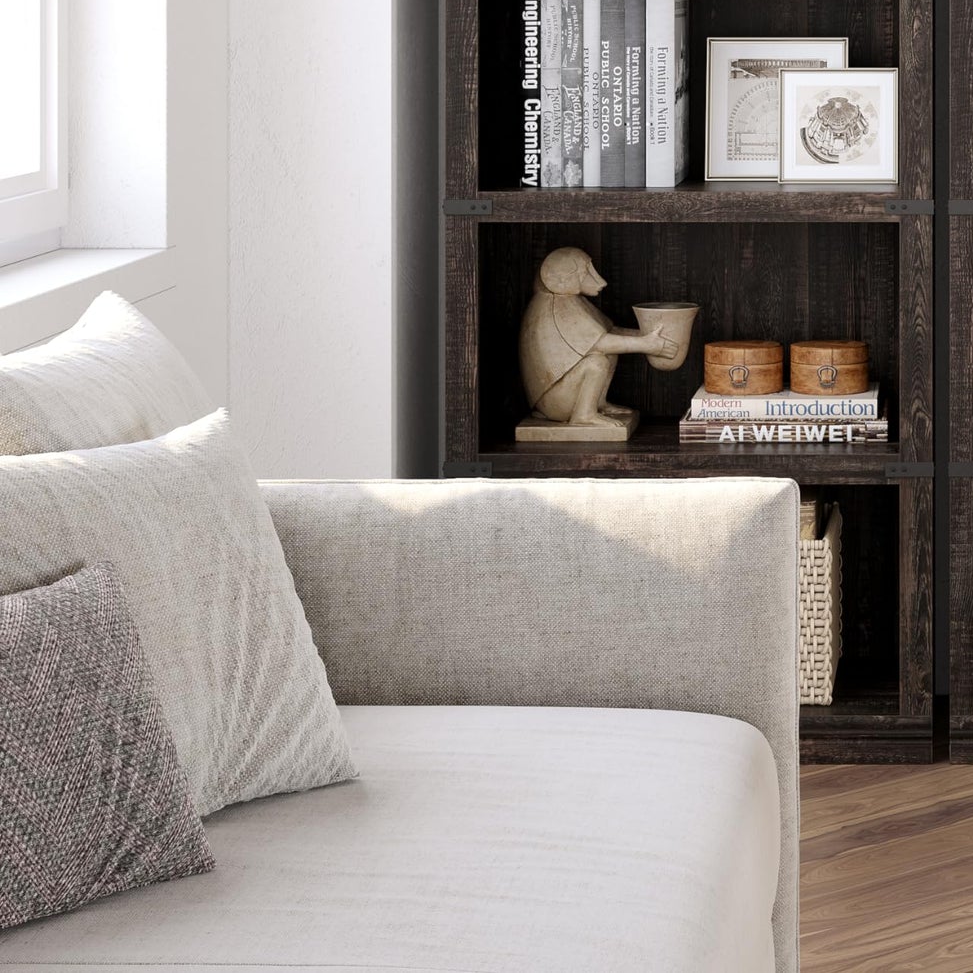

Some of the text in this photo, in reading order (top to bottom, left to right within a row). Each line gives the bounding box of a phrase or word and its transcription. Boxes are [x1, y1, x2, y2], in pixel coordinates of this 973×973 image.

[562, 84, 582, 136] ENGLAND
[592, 72, 600, 129] ONTARIO
[601, 40, 610, 150] PUBLIC SCHOOL
[613, 66, 623, 127] ONTARIO
[630, 46, 641, 145] Forming a Nation
[656, 46, 669, 145] Forming a Nation
[522, 99, 541, 187] Chemistry
[698, 408, 750, 418] American
[701, 398, 742, 408] Modern
[765, 400, 875, 416] Introduction
[719, 425, 853, 442] AI WEIWEI
